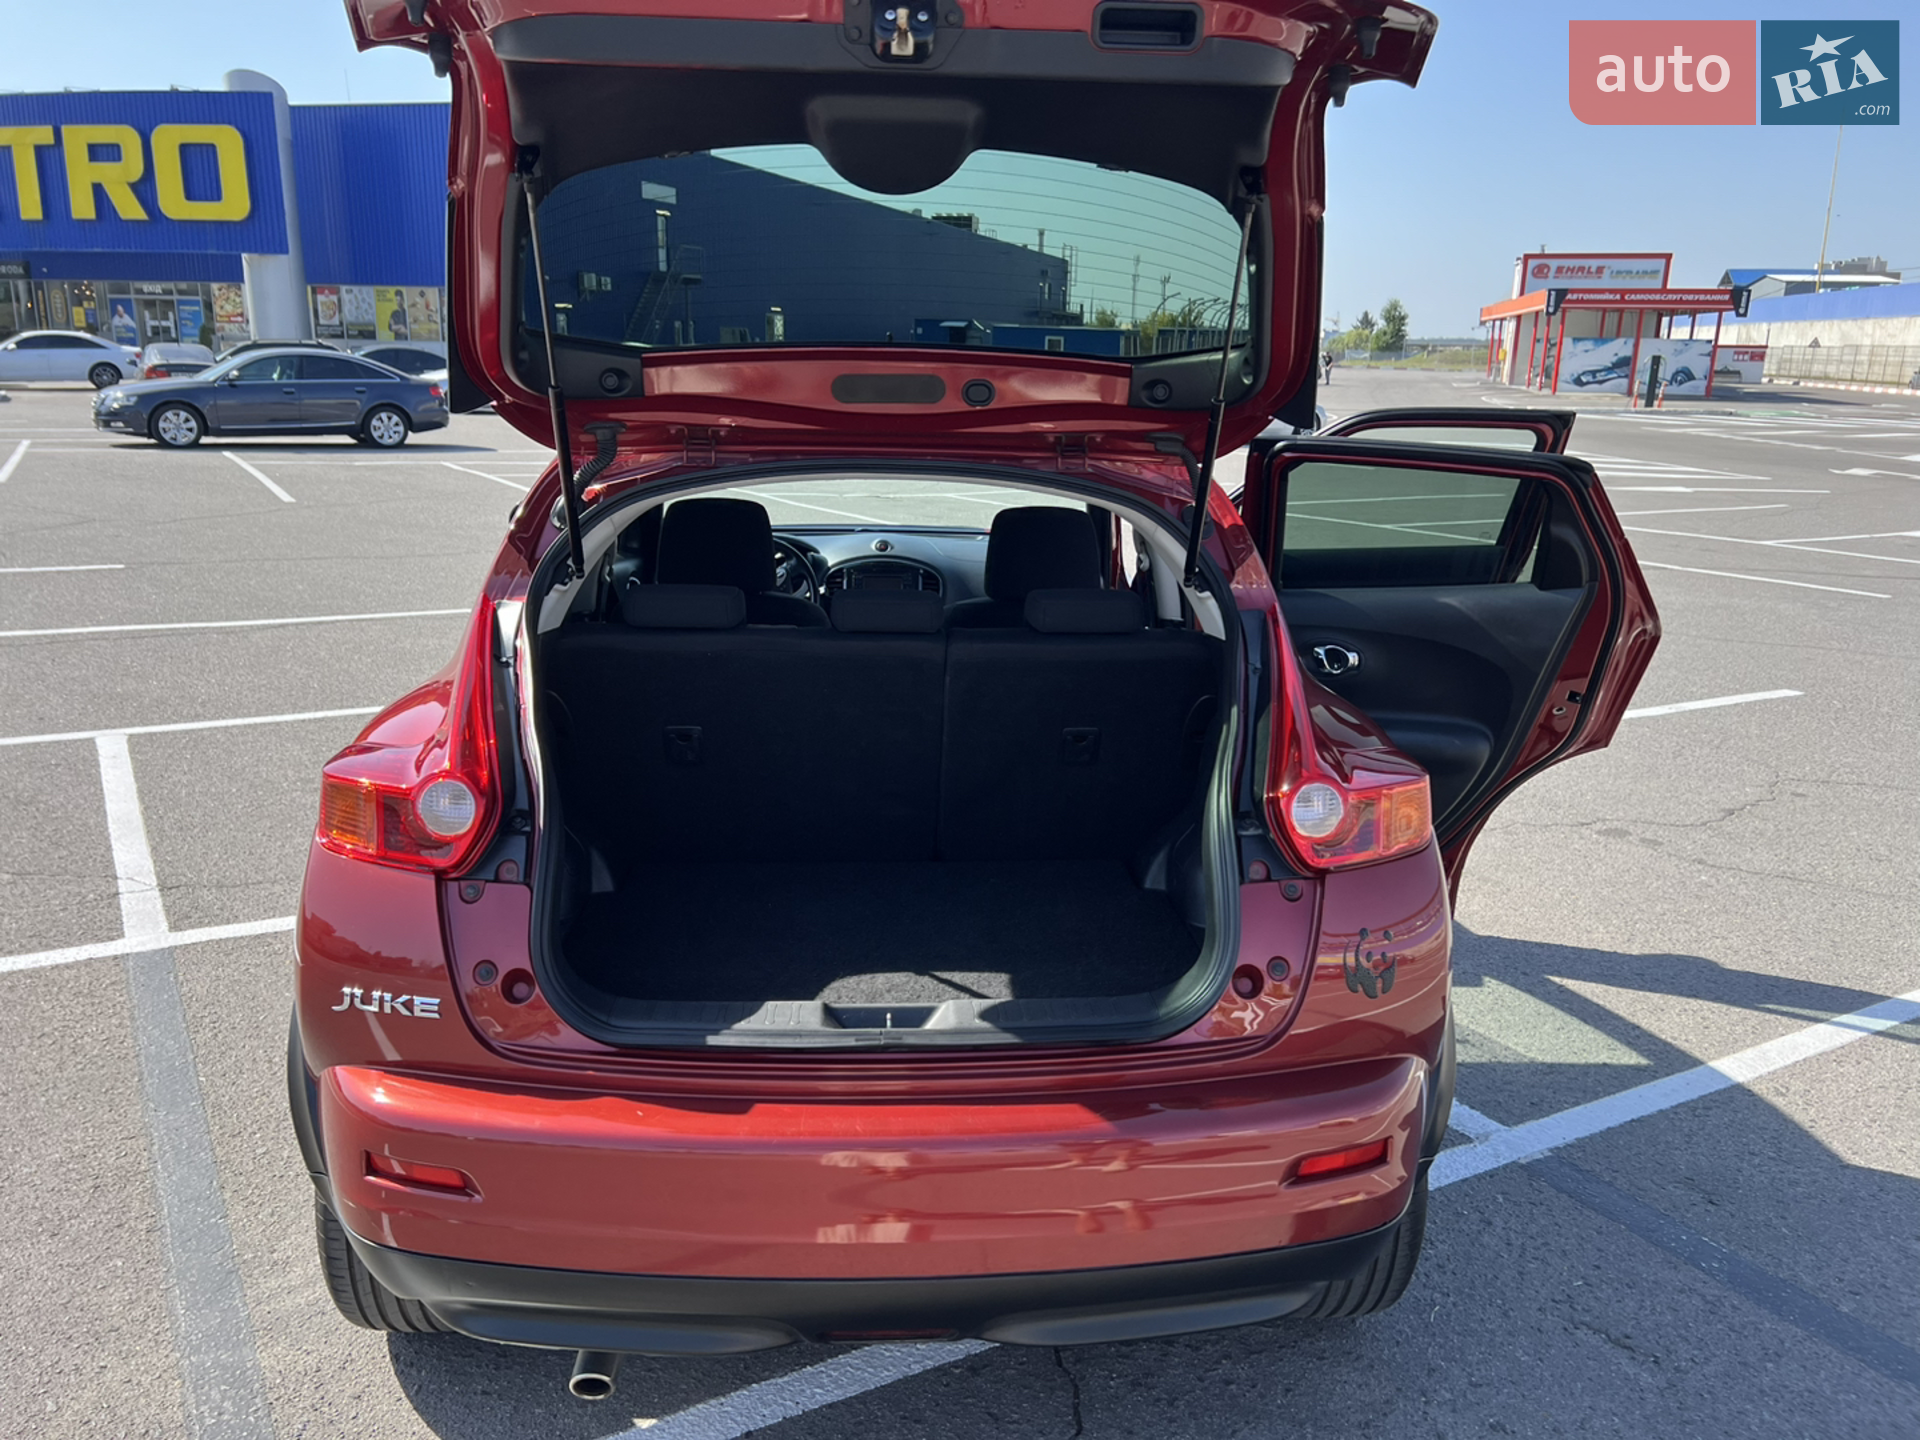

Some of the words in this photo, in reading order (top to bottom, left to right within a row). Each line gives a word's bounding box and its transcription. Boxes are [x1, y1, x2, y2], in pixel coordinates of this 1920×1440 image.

[0, 123, 251, 222] TRO
[1566, 292, 1621, 301] АВТОМИЙКА
[331, 986, 442, 1019] JUKE
